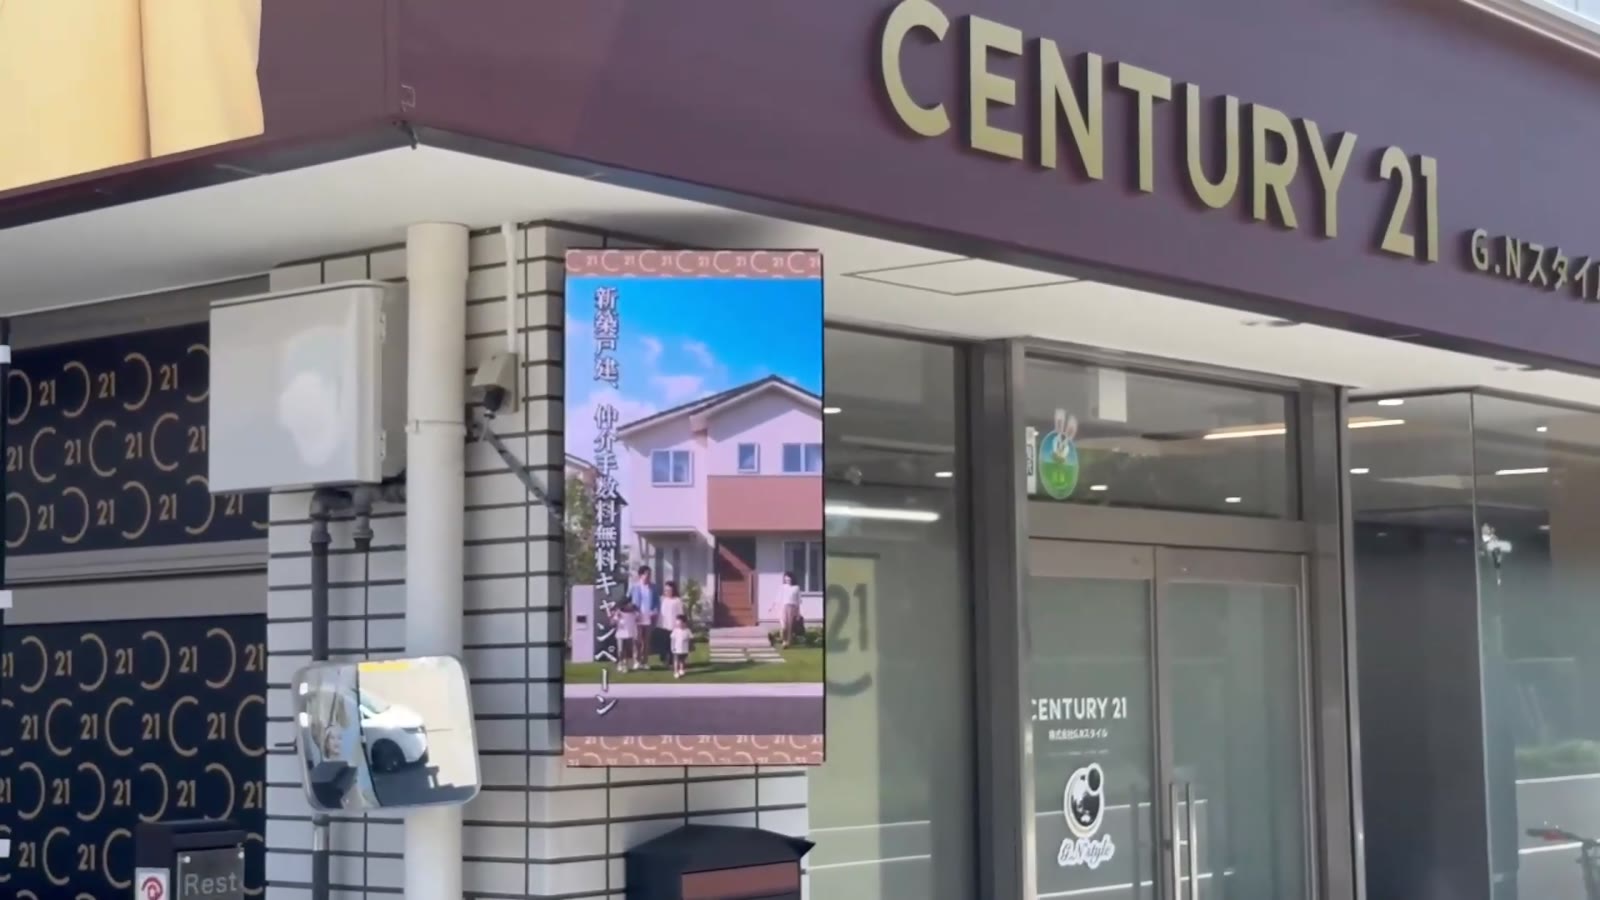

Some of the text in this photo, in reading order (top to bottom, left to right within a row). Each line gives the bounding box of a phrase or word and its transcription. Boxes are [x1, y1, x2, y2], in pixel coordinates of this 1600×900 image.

[881, 0, 1438, 262] CENTURY 21
[826, 583, 869, 653] 21
[1112, 696, 1128, 719] 21
[184, 872, 237, 896] Rest
